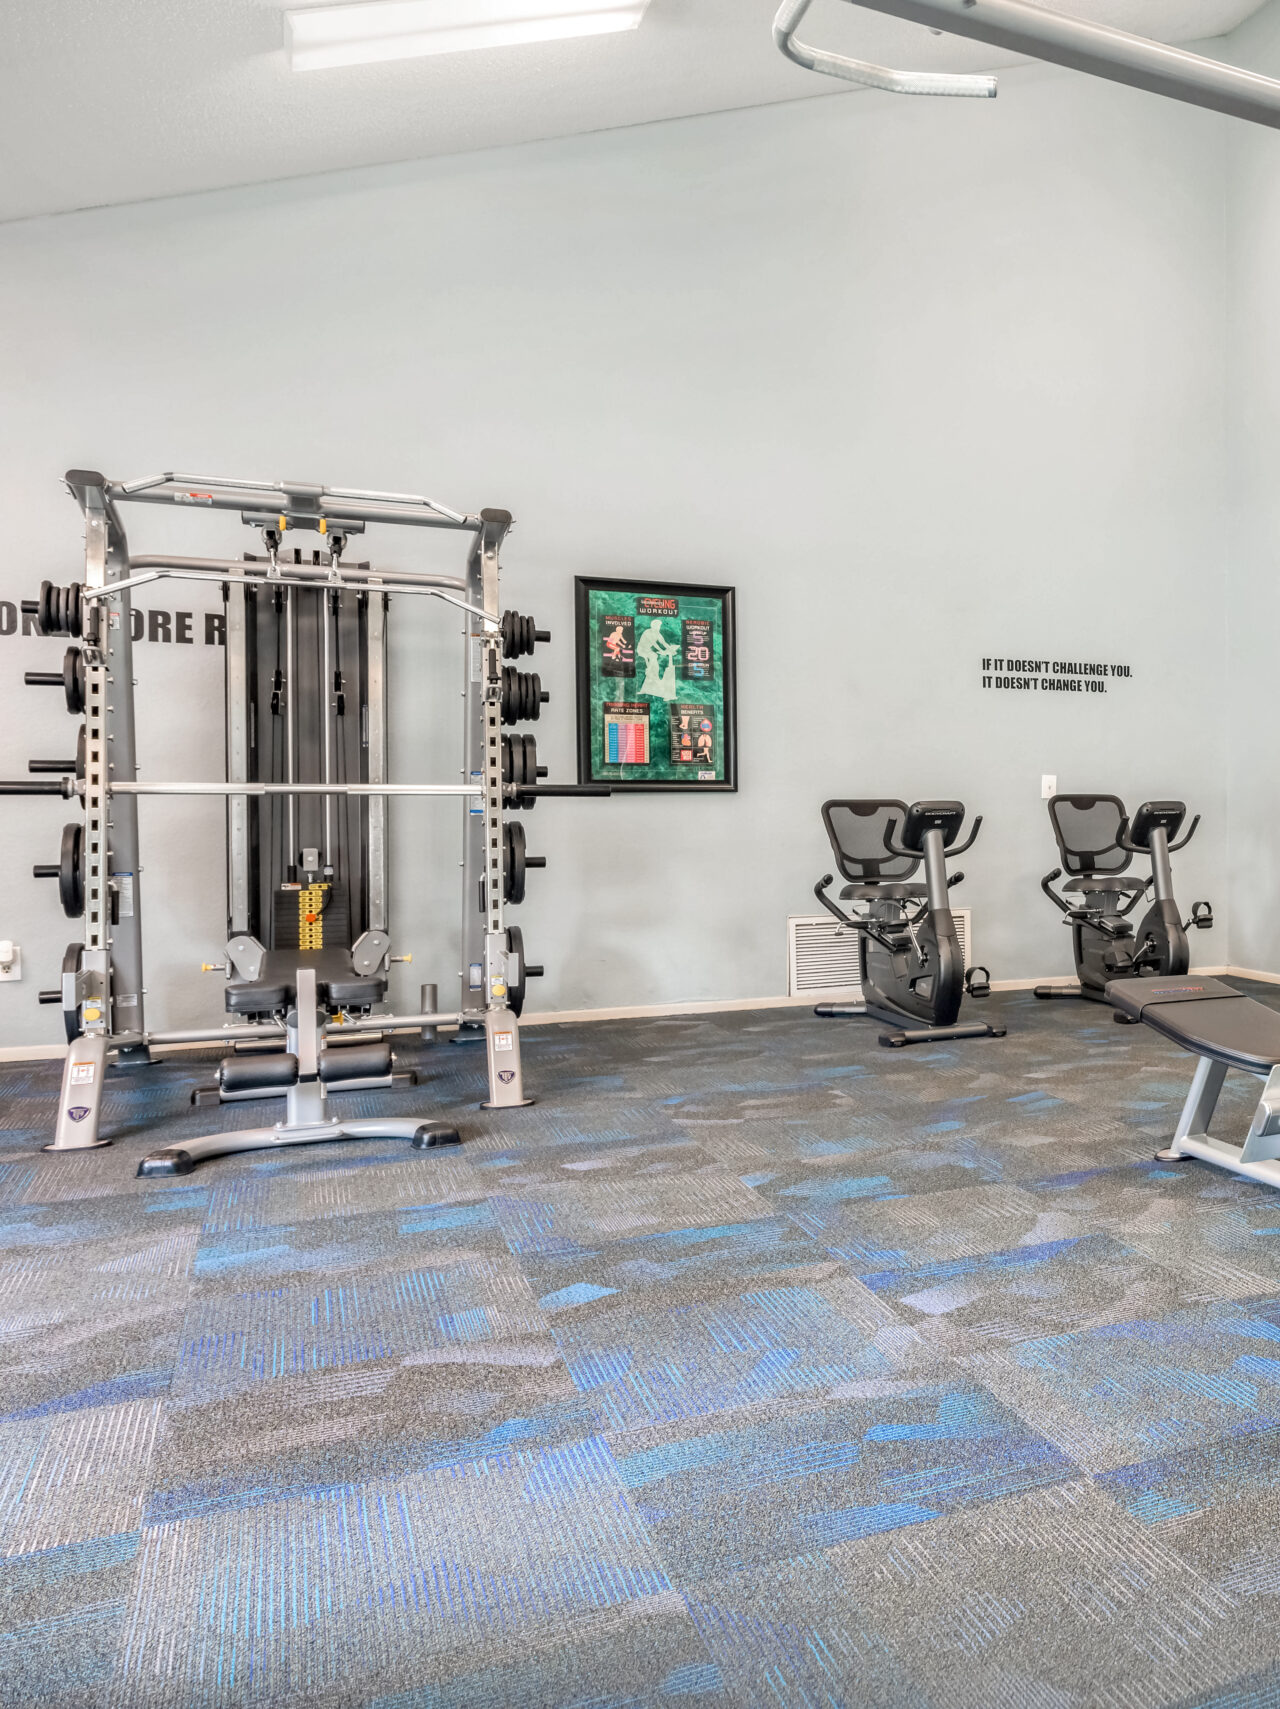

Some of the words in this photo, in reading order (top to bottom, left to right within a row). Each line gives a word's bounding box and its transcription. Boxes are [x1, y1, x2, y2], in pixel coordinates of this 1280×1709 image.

[639, 607, 678, 615] WORKOUT
[687, 646, 709, 661] 20
[982, 658, 992, 671] IF
[994, 658, 1004, 671] IT
[1006, 659, 1050, 674] DOESN'T
[1052, 661, 1108, 676] CHALLENGE
[1110, 664, 1133, 678] YOU.
[982, 676, 993, 688] IT
[995, 676, 1039, 690] DOESN'T
[1041, 678, 1082, 692] CHANGE
[1084, 680, 1108, 693] YOU.
